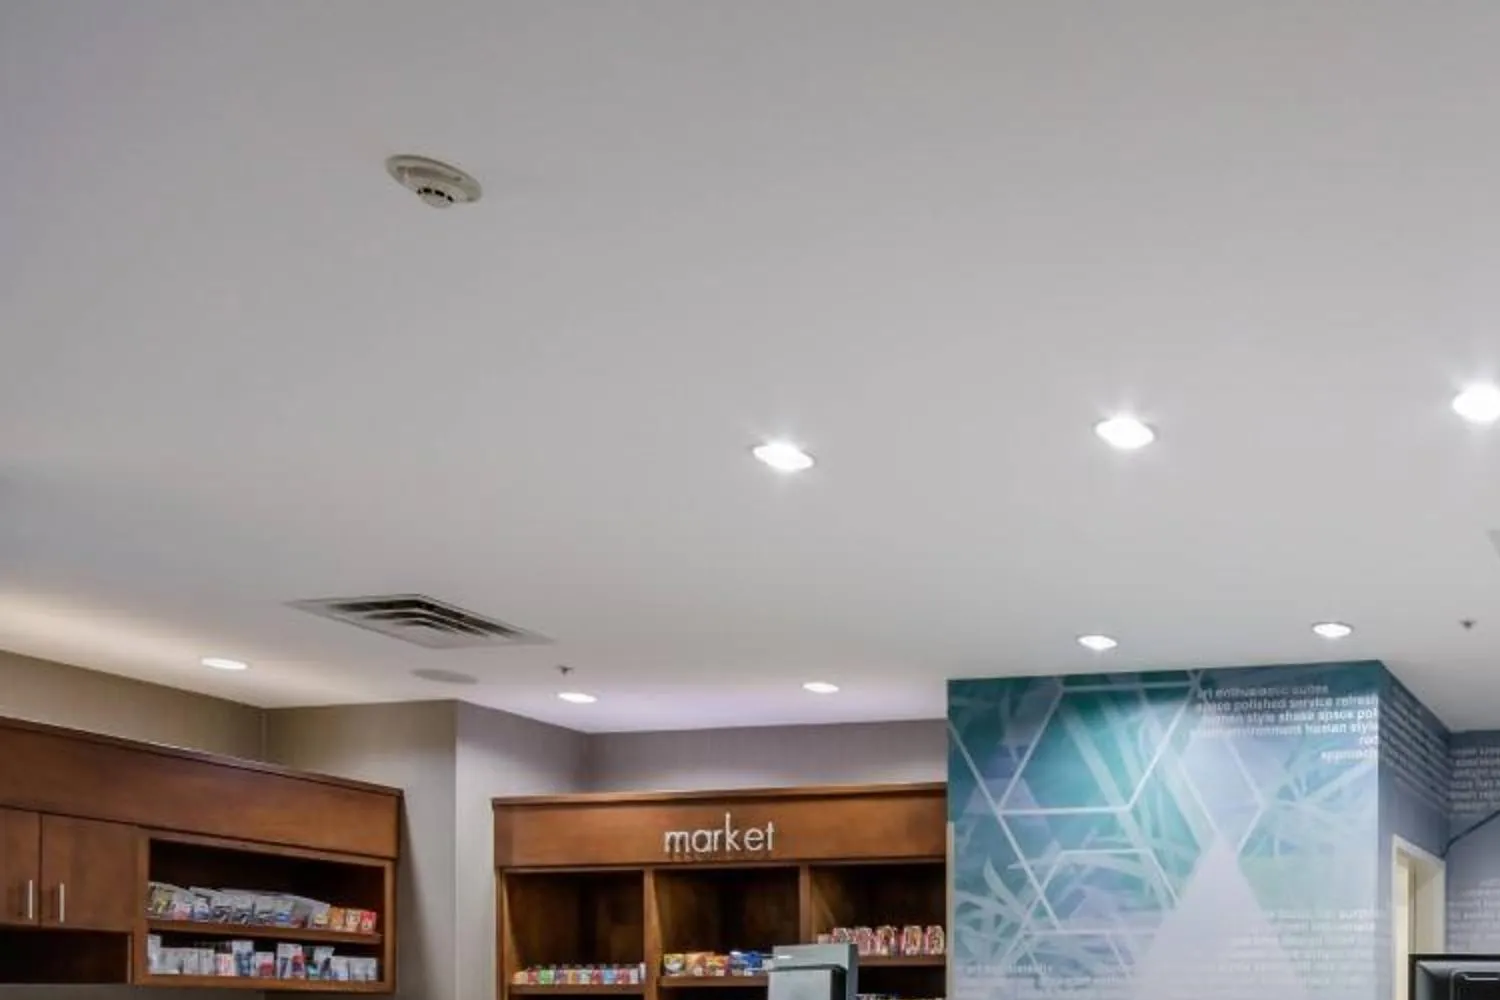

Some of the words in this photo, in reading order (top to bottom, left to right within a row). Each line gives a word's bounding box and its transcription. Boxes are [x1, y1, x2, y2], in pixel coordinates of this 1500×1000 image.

[1233, 698, 1287, 712] polished
[1288, 696, 1333, 709] service
[1279, 711, 1315, 723] shake
[664, 811, 776, 853] market
